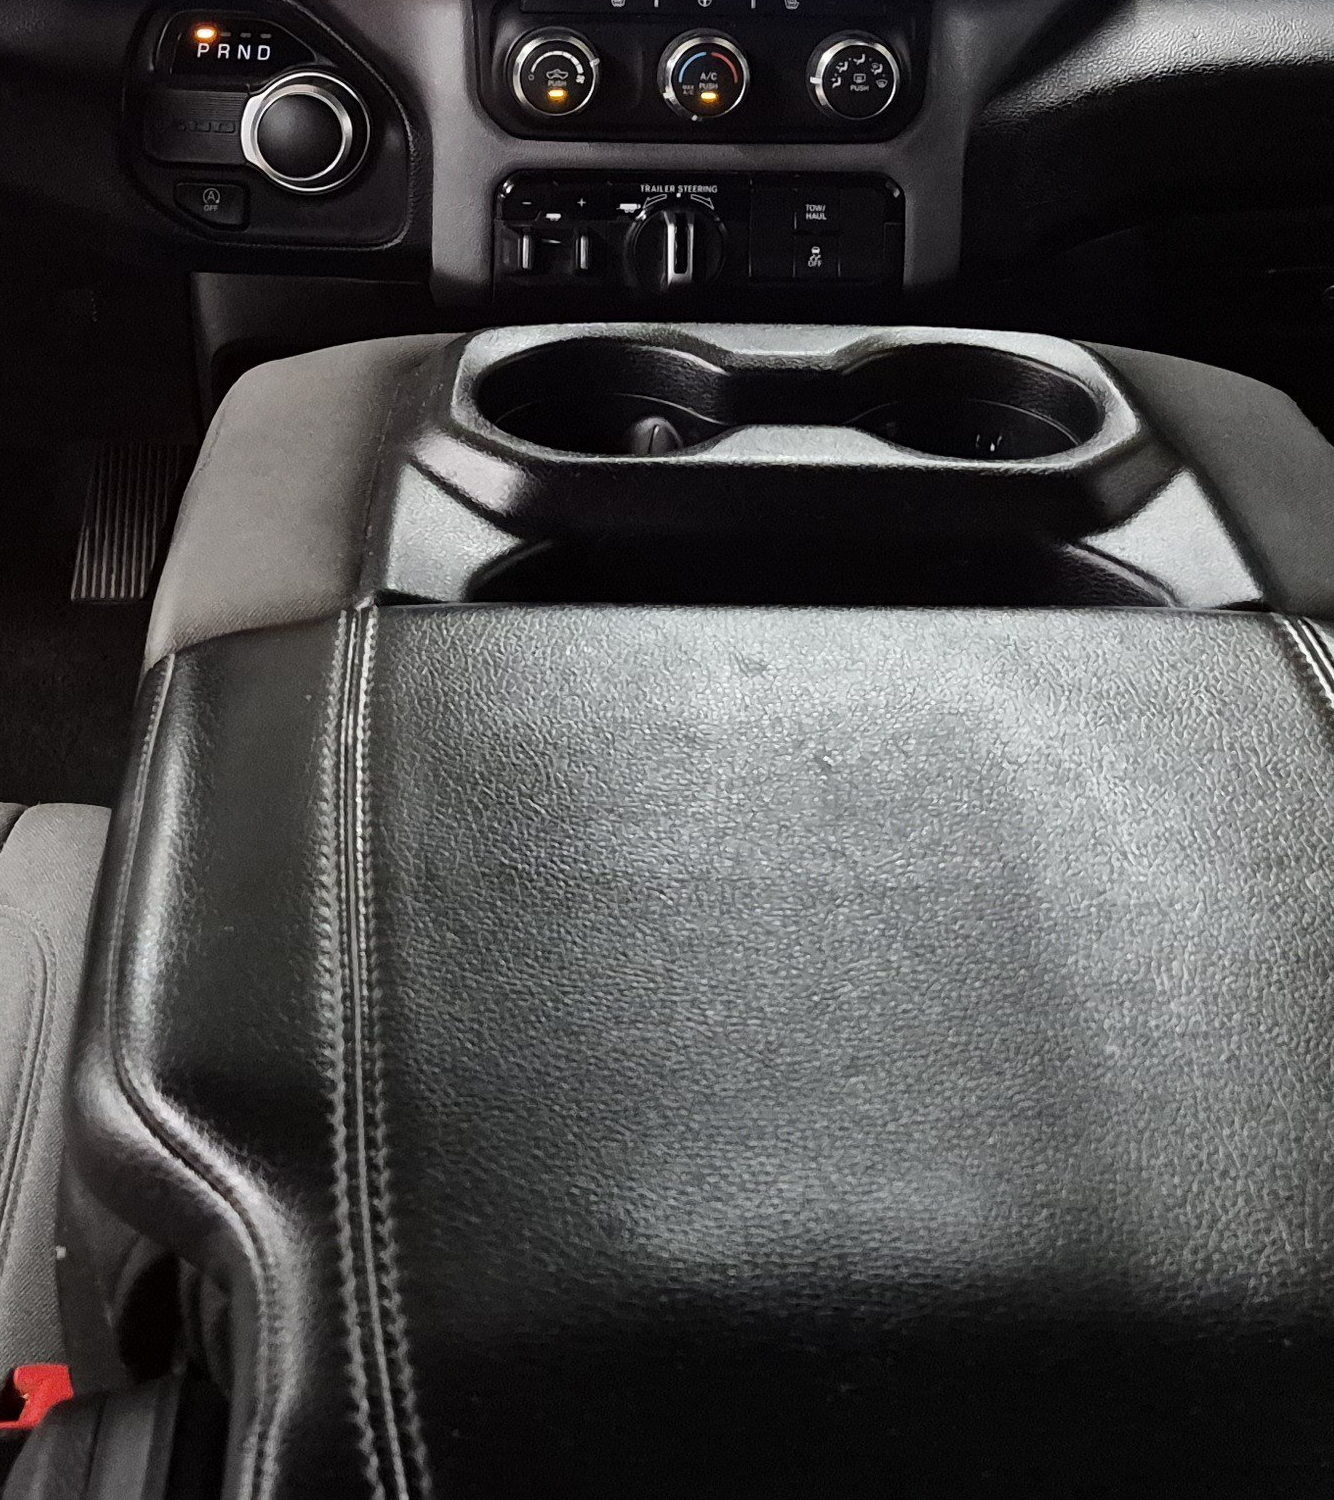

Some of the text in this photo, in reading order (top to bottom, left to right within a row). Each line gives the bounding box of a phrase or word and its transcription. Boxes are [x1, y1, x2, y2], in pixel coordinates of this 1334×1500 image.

[197, 43, 271, 61] P R N D
[700, 71, 717, 81] A/C
[548, 80, 567, 88] PUSH
[699, 82, 718, 90] PUSH
[850, 84, 869, 92] PUSH
[641, 184, 717, 194] TRAILER STEERING
[204, 204, 218, 212] OFF
[806, 212, 827, 221] HAUL
[808, 259, 822, 268] OFF
